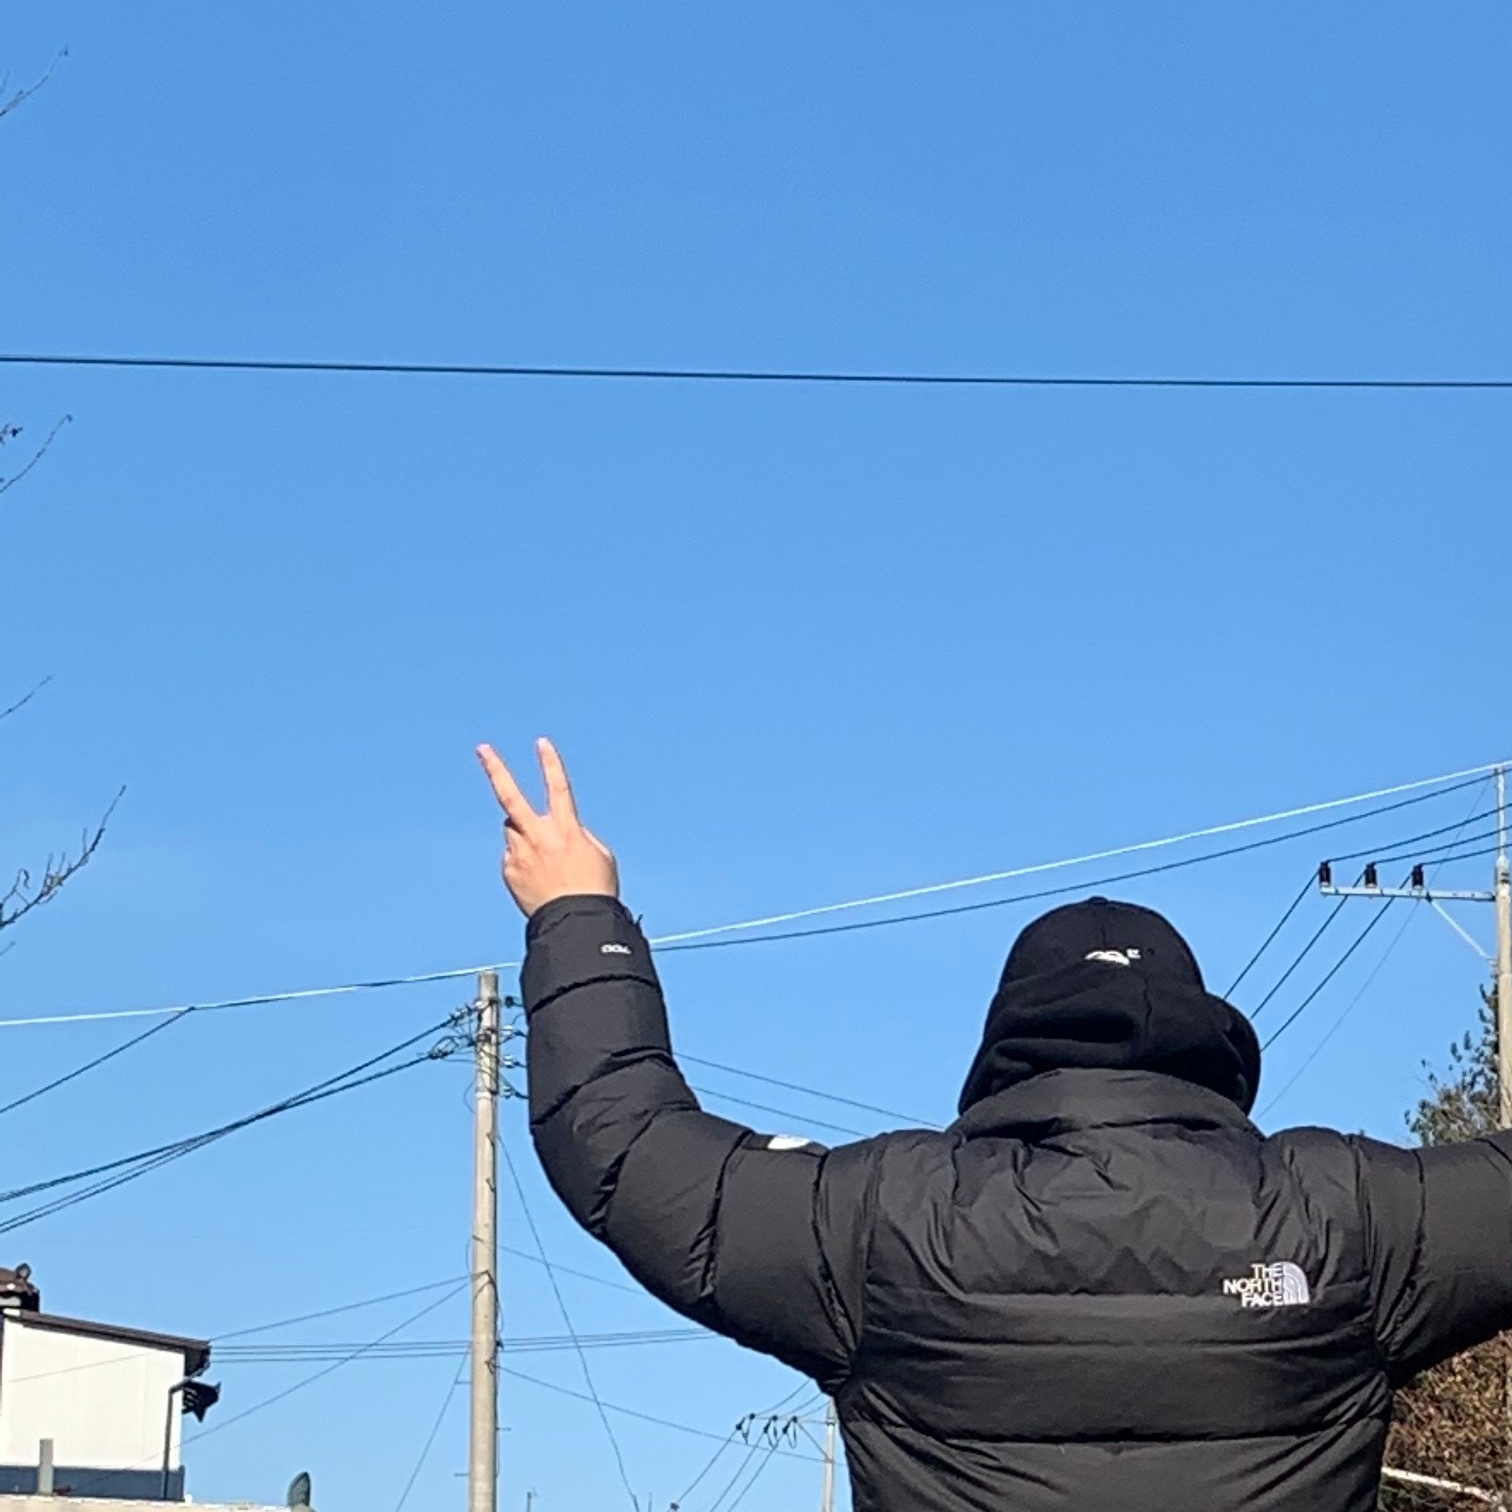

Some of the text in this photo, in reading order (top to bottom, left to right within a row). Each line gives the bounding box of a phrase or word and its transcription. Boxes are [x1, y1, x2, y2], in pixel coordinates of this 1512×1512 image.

[1250, 1263, 1283, 1279] THE
[1223, 1278, 1282, 1295] NORTH
[1242, 1291, 1284, 1308] FACE
